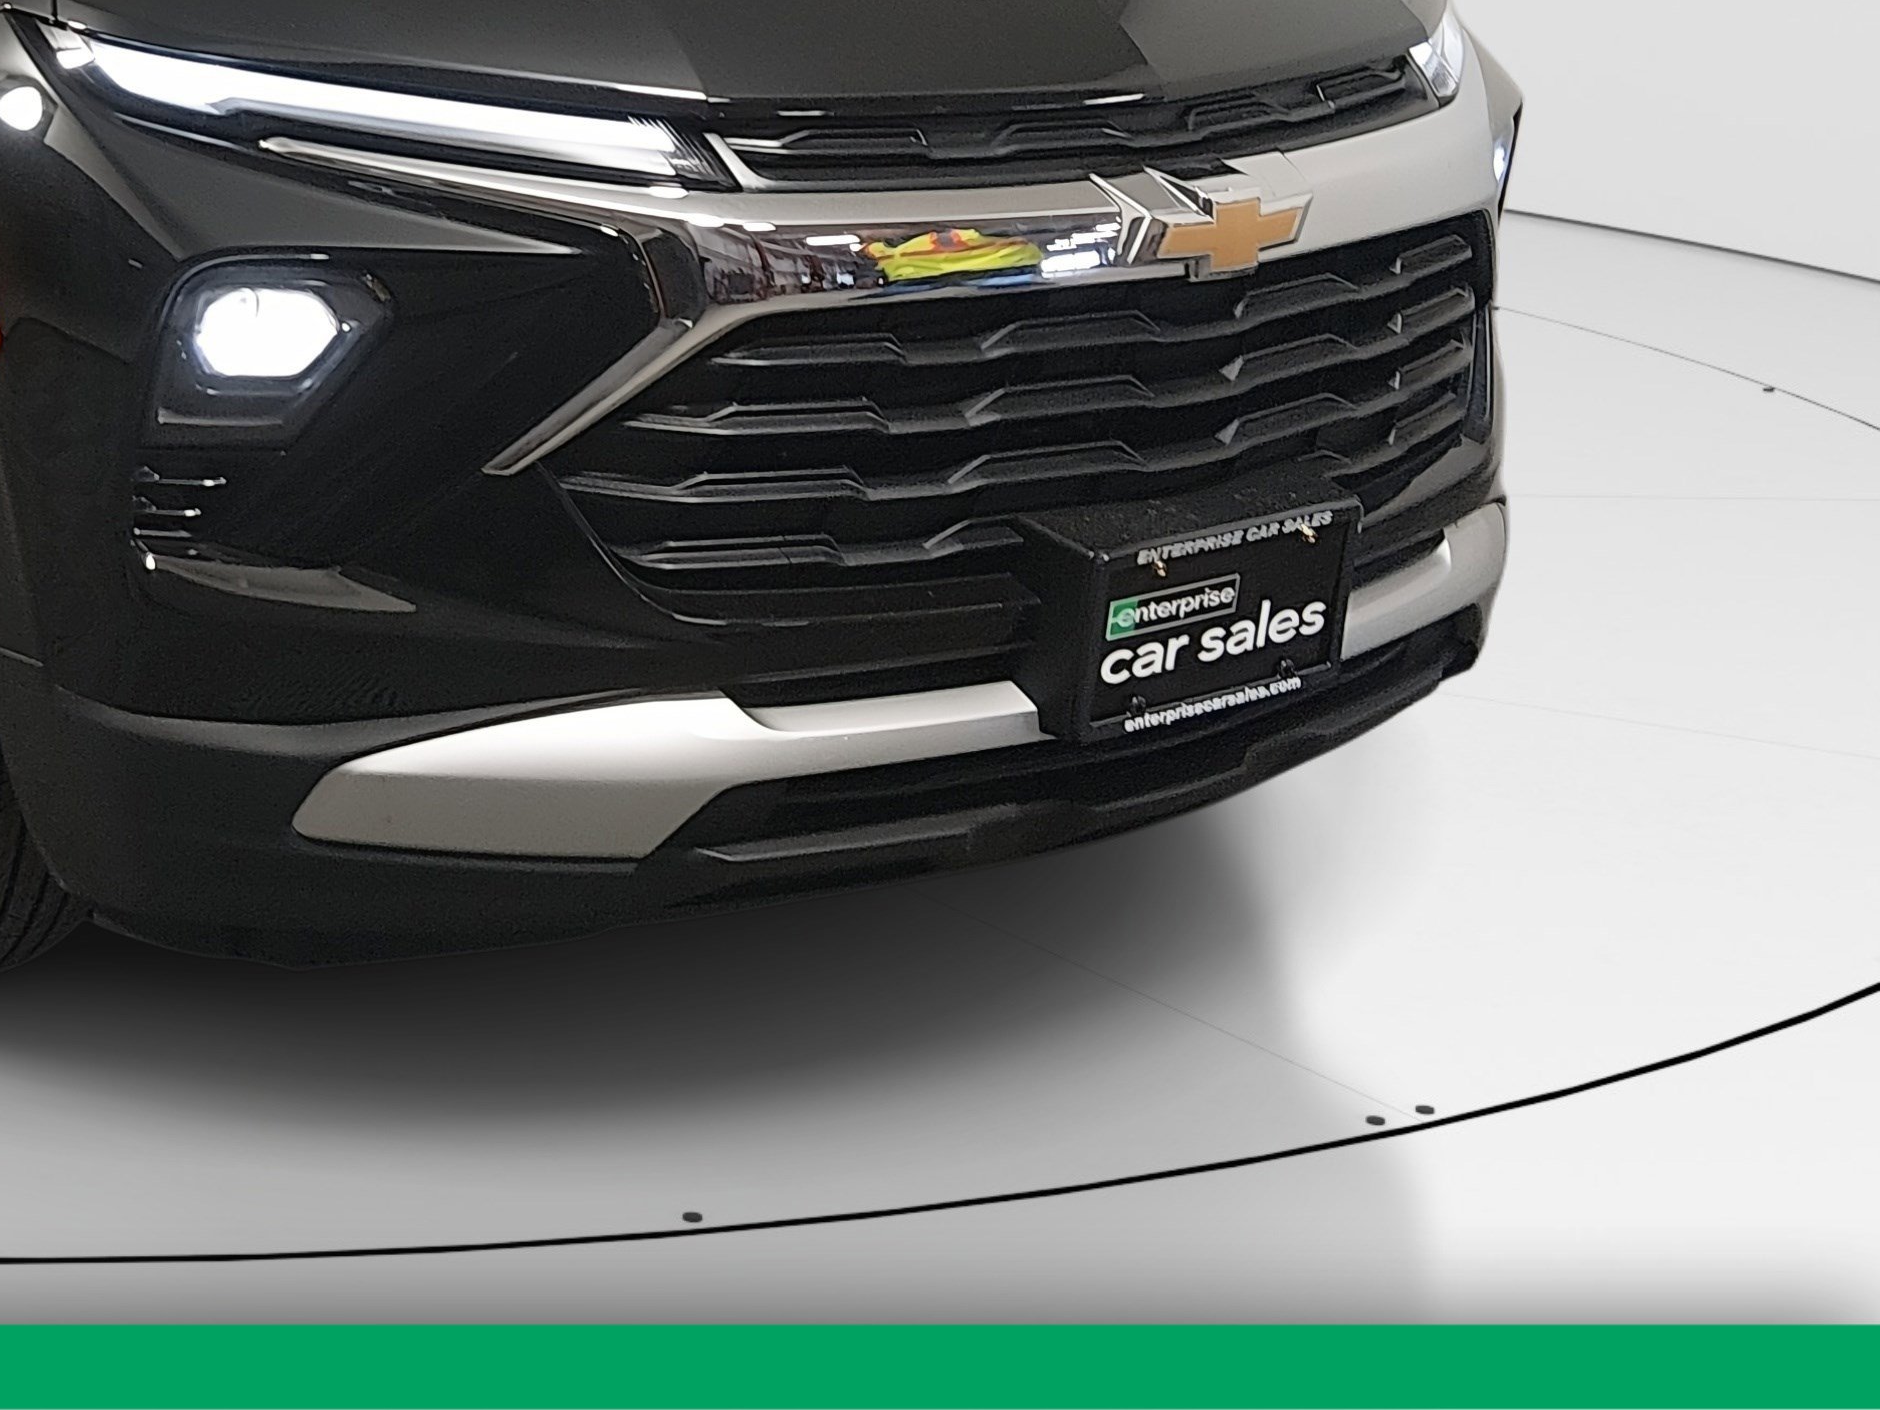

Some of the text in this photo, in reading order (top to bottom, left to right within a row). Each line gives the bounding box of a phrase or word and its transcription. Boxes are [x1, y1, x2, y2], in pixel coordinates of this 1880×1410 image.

[1136, 529, 1245, 566] ENTERPRISE
[1246, 521, 1280, 541] CAR
[1116, 586, 1236, 627] enterprise
[1099, 598, 1327, 685] car sales
